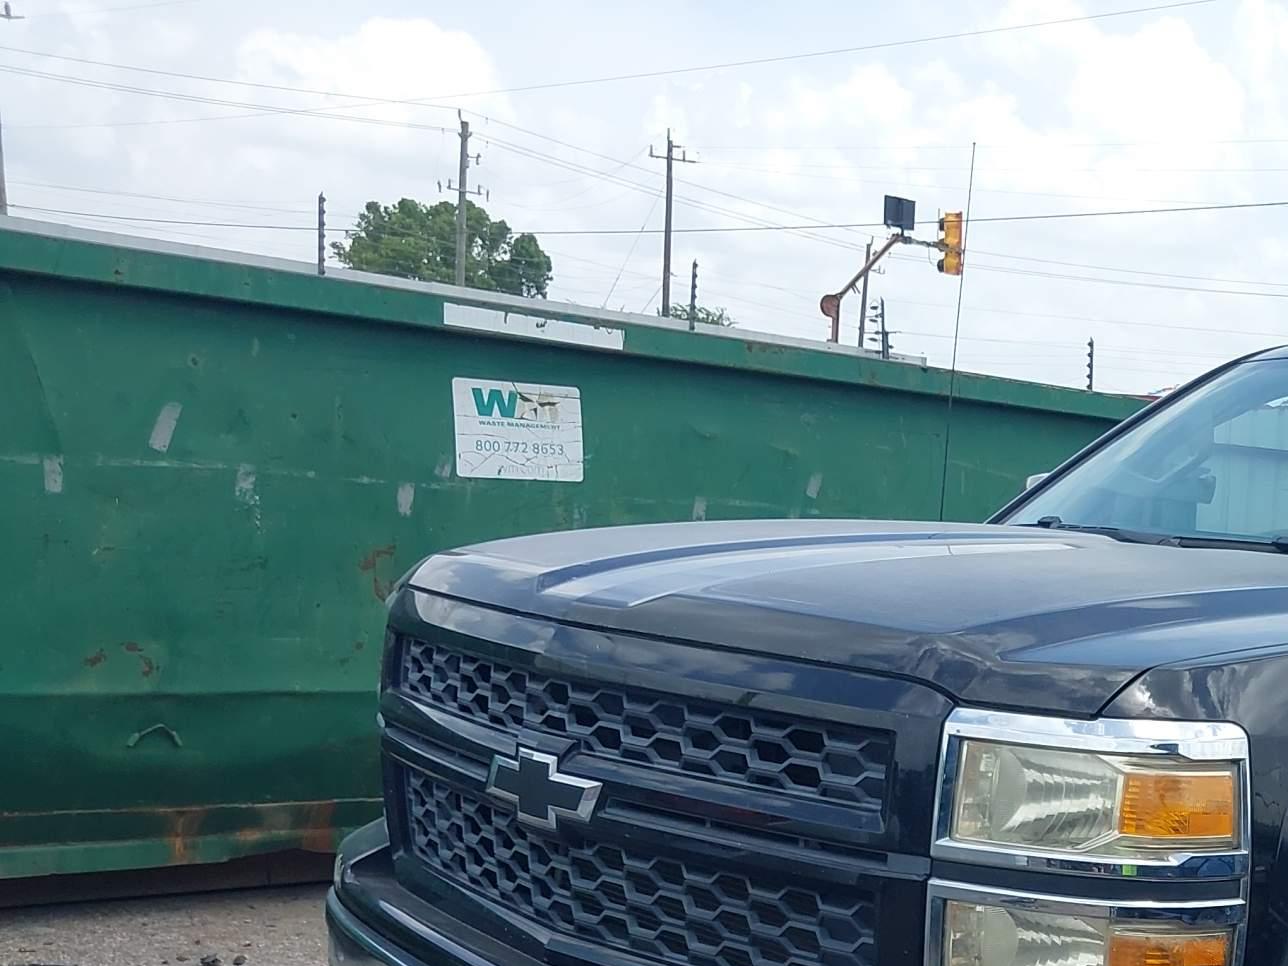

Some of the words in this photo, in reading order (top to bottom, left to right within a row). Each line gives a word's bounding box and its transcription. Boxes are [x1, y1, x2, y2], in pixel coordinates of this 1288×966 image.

[479, 419, 505, 428] WASTE
[507, 421, 560, 431] MANAGEMENT
[475, 440, 501, 453] 800
[504, 441, 529, 454] 772
[532, 443, 565, 456] 8653
